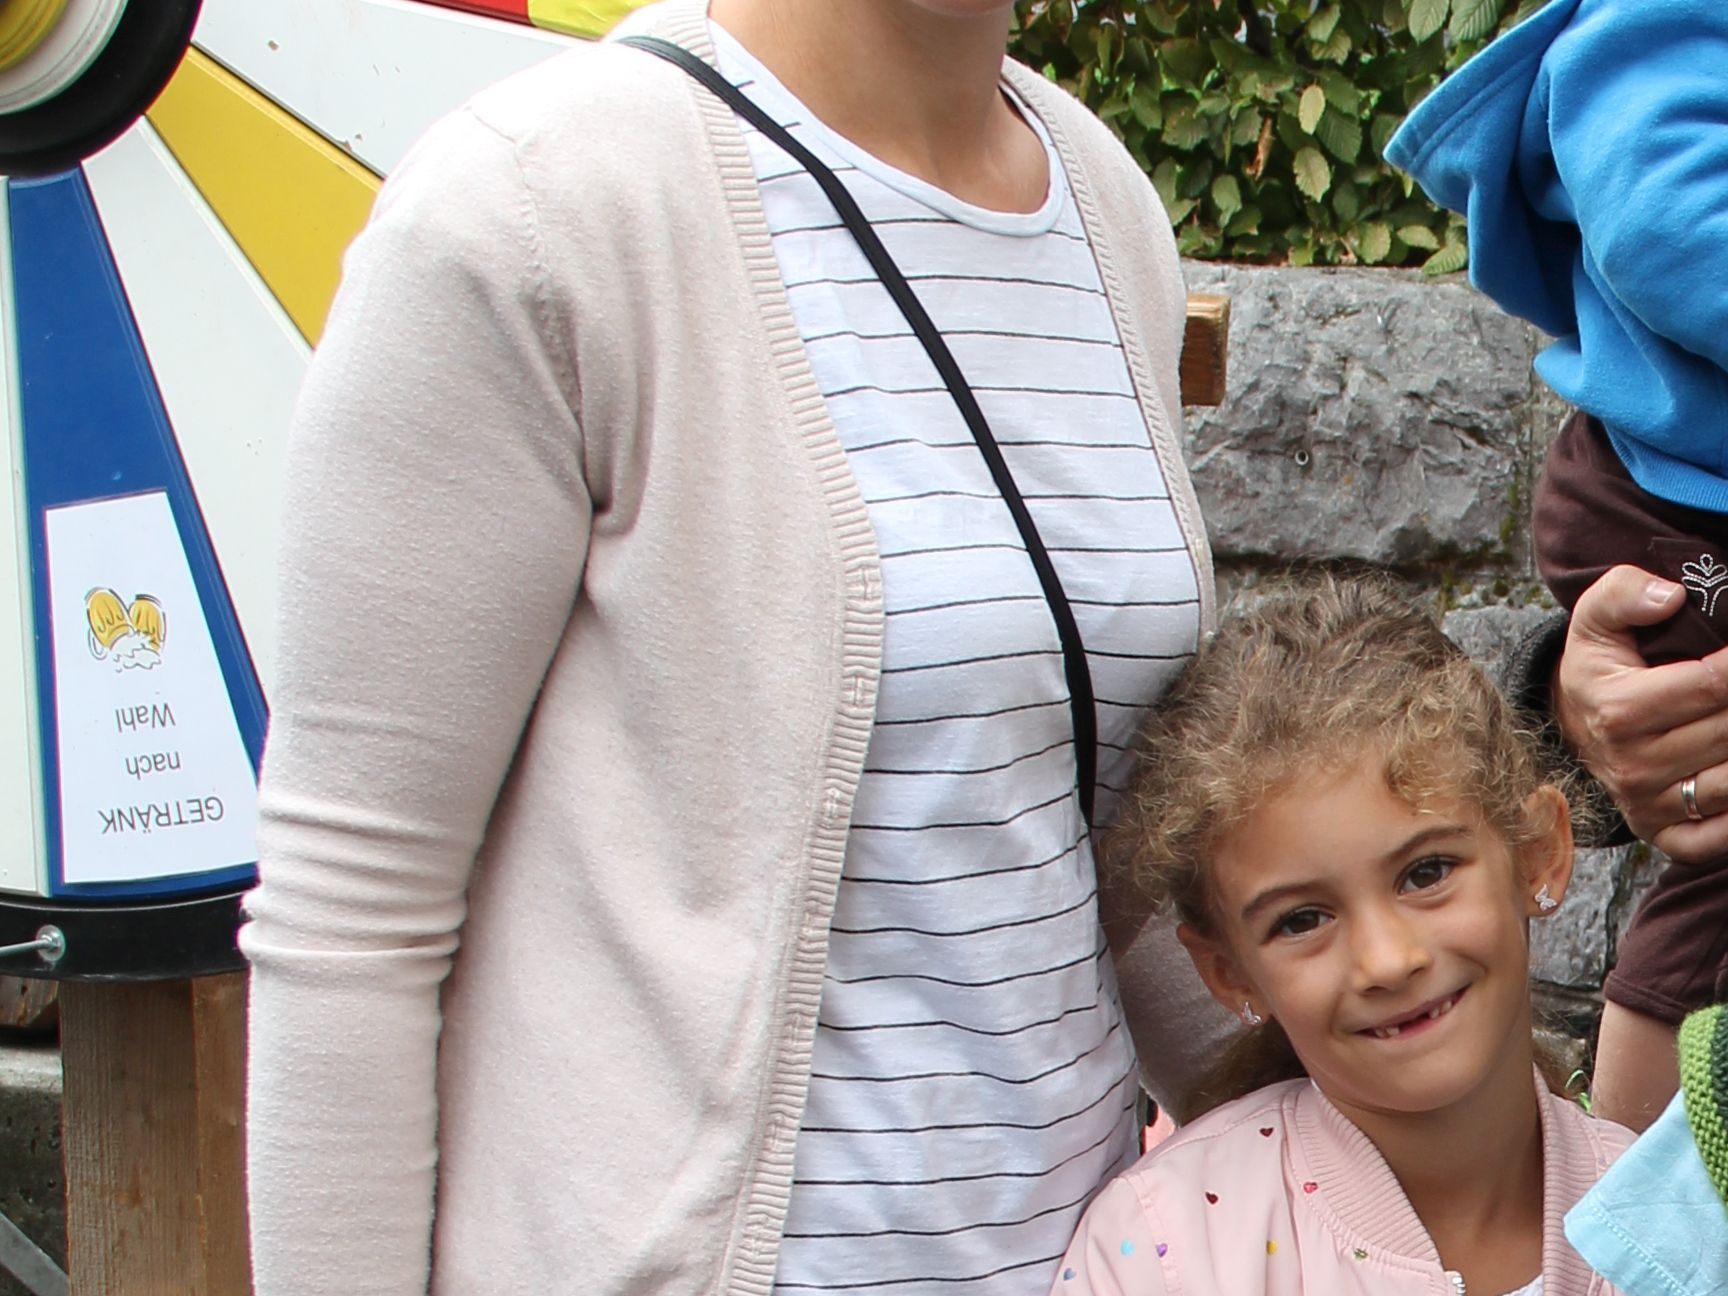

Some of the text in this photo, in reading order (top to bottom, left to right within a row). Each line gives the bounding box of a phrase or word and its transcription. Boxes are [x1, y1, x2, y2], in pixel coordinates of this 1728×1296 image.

[115, 702, 177, 733] Wahl
[125, 751, 182, 780] nach
[98, 795, 225, 835] GETRÄNK
